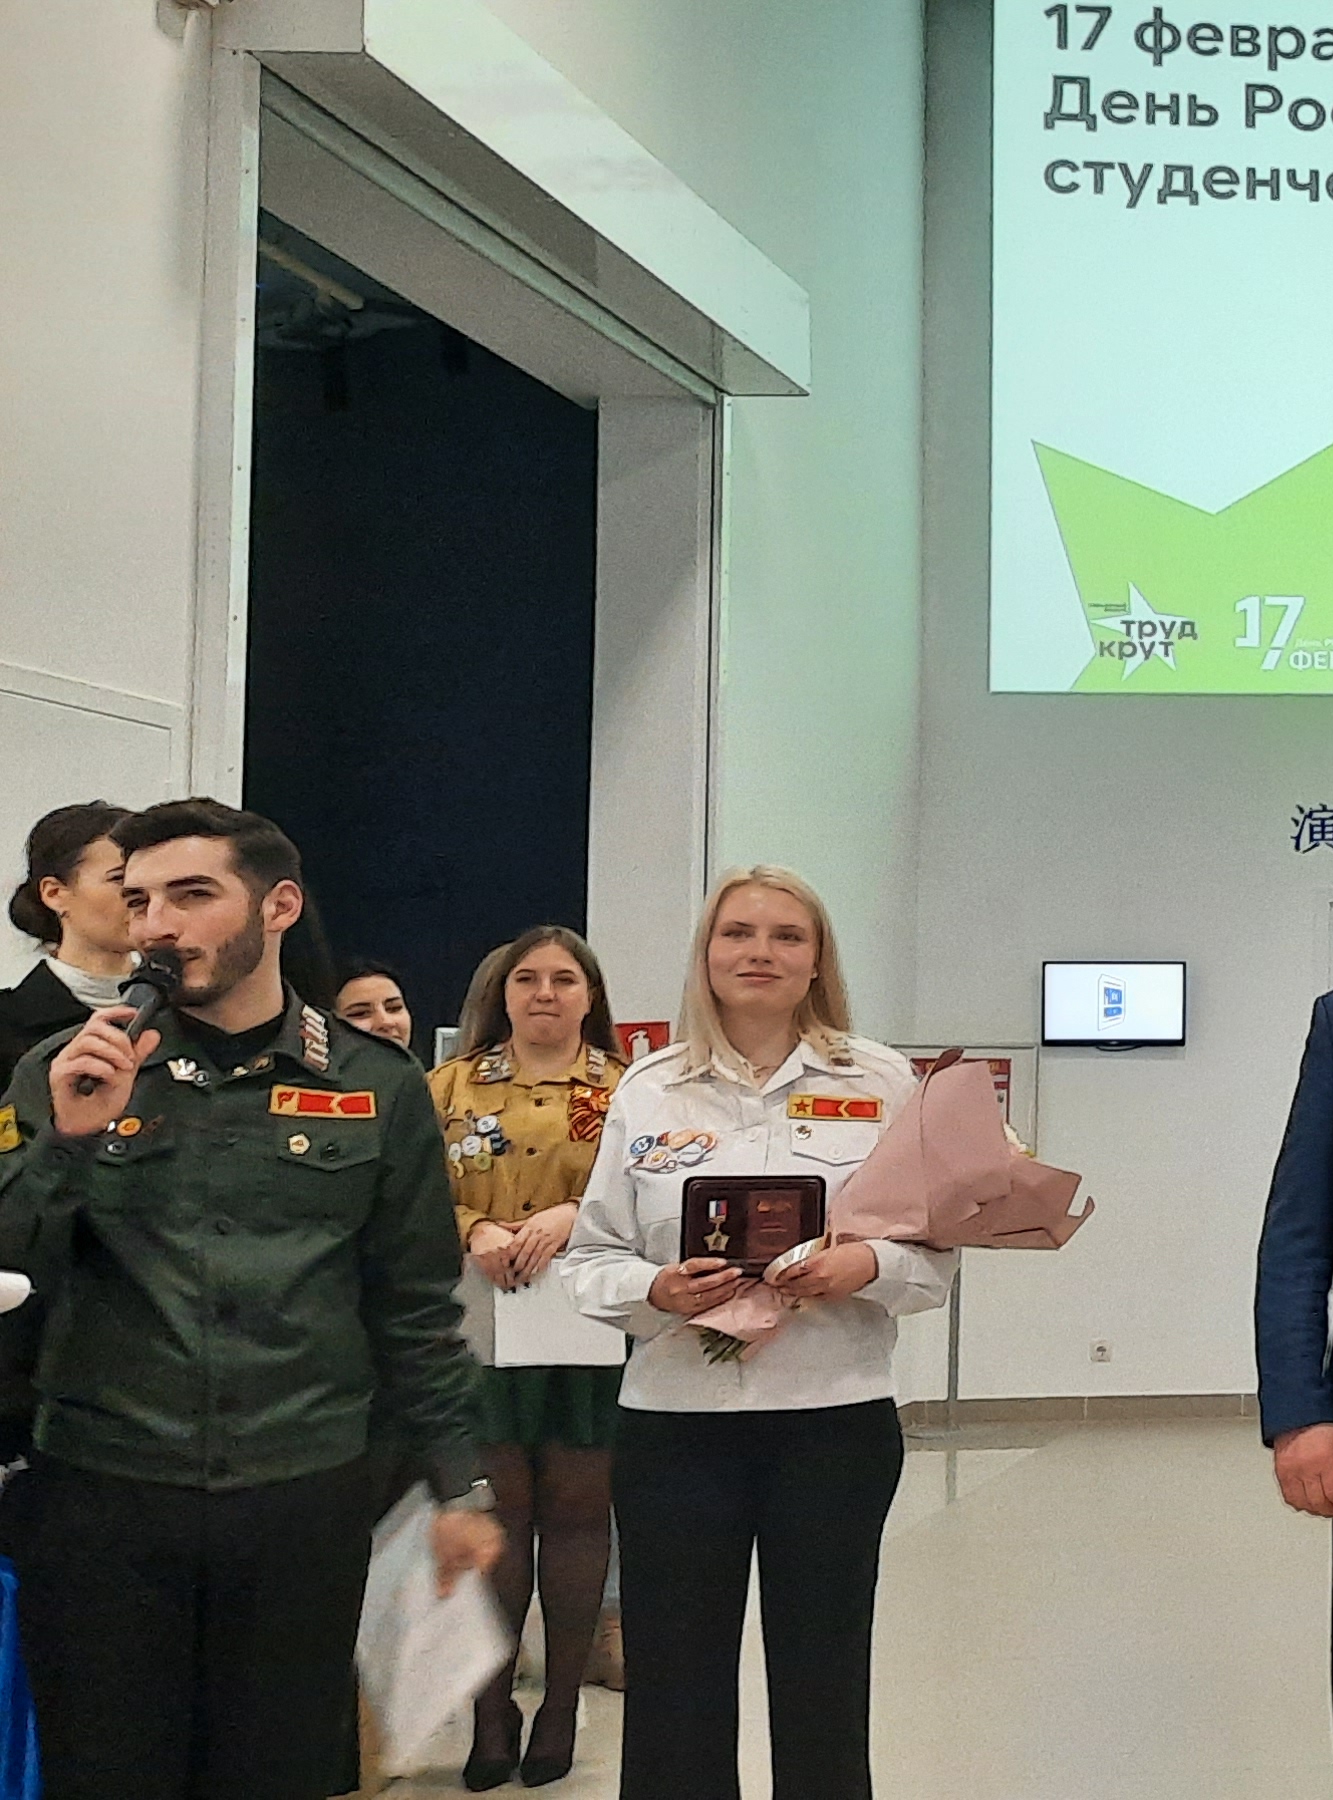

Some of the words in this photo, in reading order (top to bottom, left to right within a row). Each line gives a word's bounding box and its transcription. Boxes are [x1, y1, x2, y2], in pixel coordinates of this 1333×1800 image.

[1044, 4, 1112, 51] 17
[1043, 74, 1219, 132] День
[1099, 640, 1175, 661] крут
[1120, 619, 1199, 641] труд
[1233, 595, 1306, 671] 17
